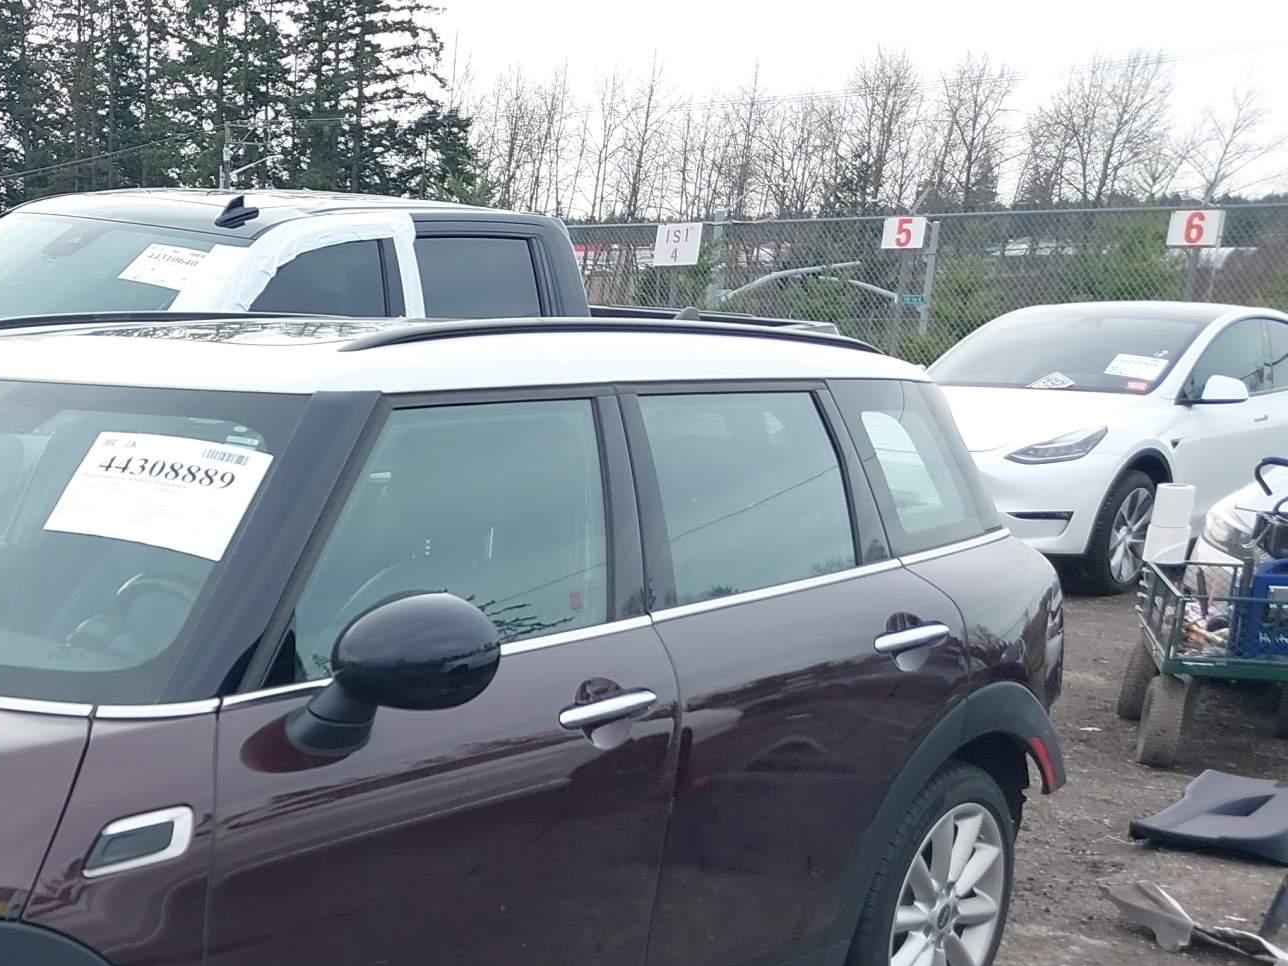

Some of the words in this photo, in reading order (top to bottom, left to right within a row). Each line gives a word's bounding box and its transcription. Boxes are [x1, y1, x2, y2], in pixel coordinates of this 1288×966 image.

[895, 218, 913, 247] 5
[1184, 212, 1206, 243] 6
[670, 248, 678, 262] 4
[98, 455, 235, 489] 44308889
